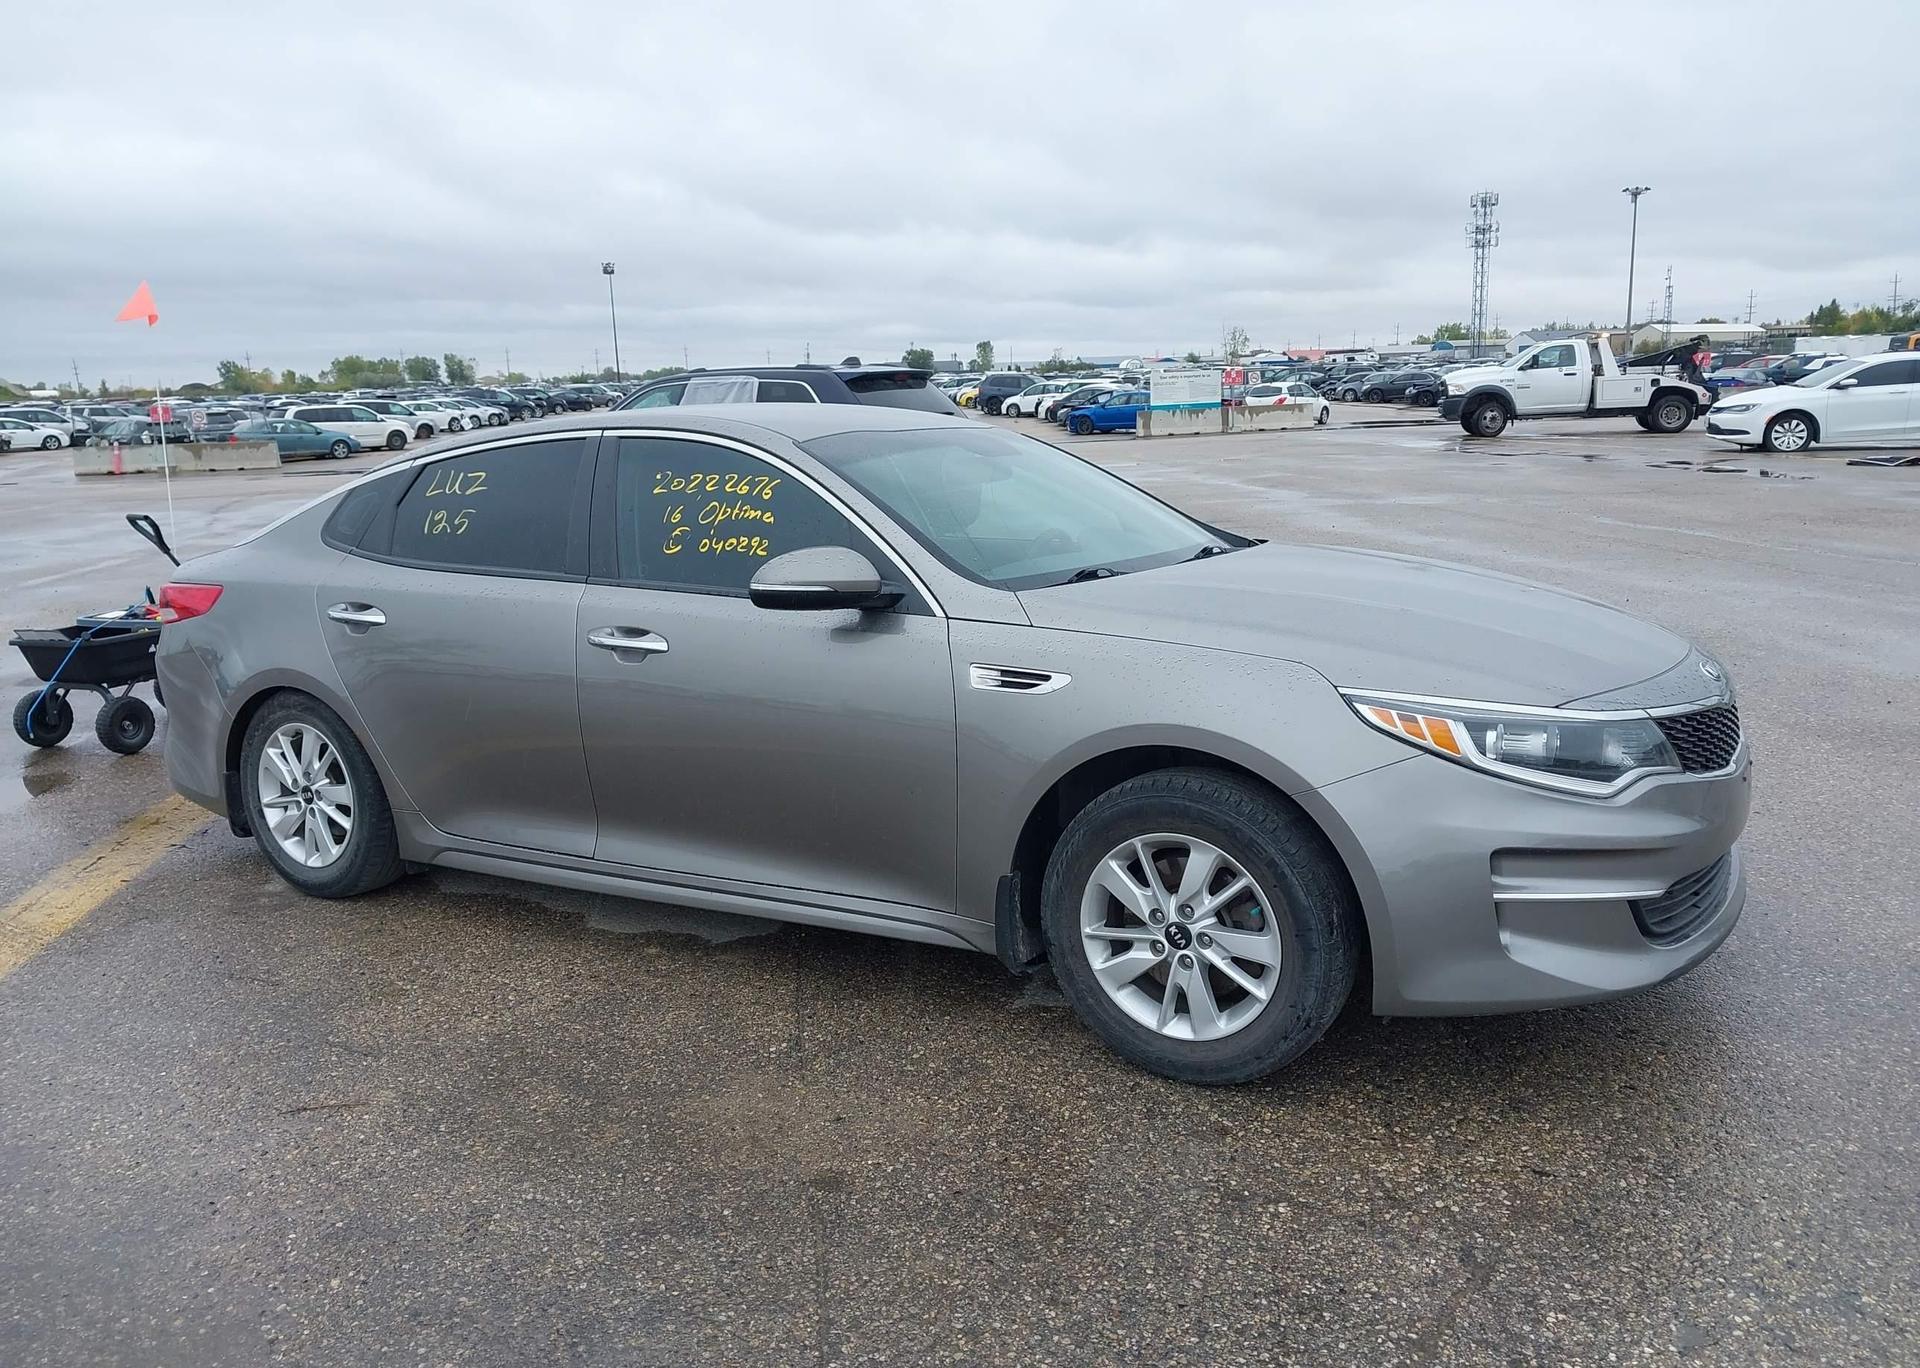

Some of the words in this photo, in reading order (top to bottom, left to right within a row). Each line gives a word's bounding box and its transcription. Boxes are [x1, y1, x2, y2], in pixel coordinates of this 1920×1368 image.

[425, 469, 488, 497] LUZ
[653, 471, 782, 500] 20222676
[424, 509, 476, 534] 125
[663, 505, 684, 523] 16
[698, 500, 775, 526] Optima
[1169, 925, 1185, 948] KIA
